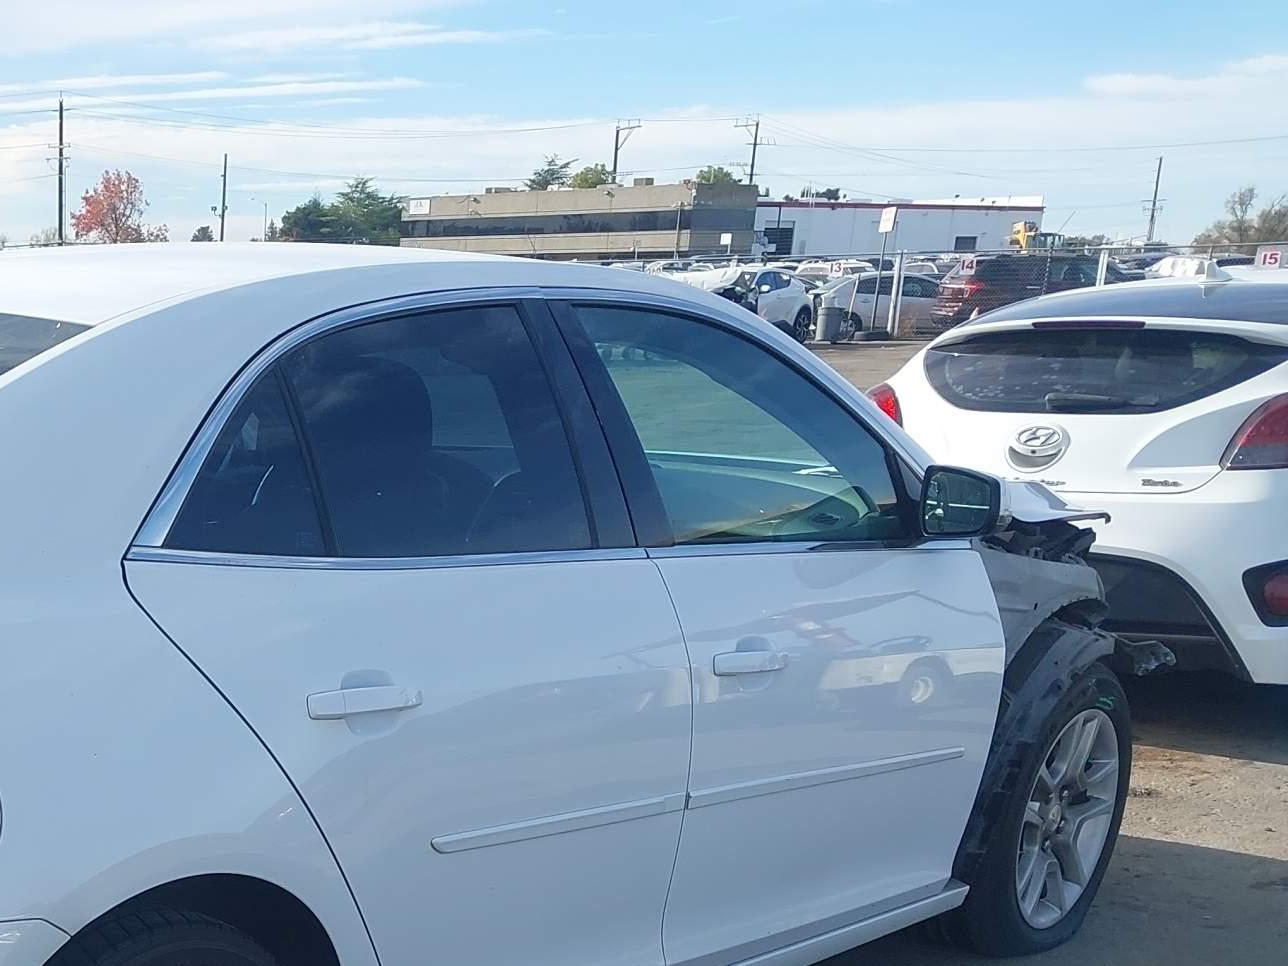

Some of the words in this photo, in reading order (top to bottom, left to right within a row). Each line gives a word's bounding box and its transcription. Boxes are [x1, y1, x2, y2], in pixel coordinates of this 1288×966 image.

[961, 259, 975, 271] 14
[1262, 252, 1279, 266] 15
[829, 262, 842, 273] 13
